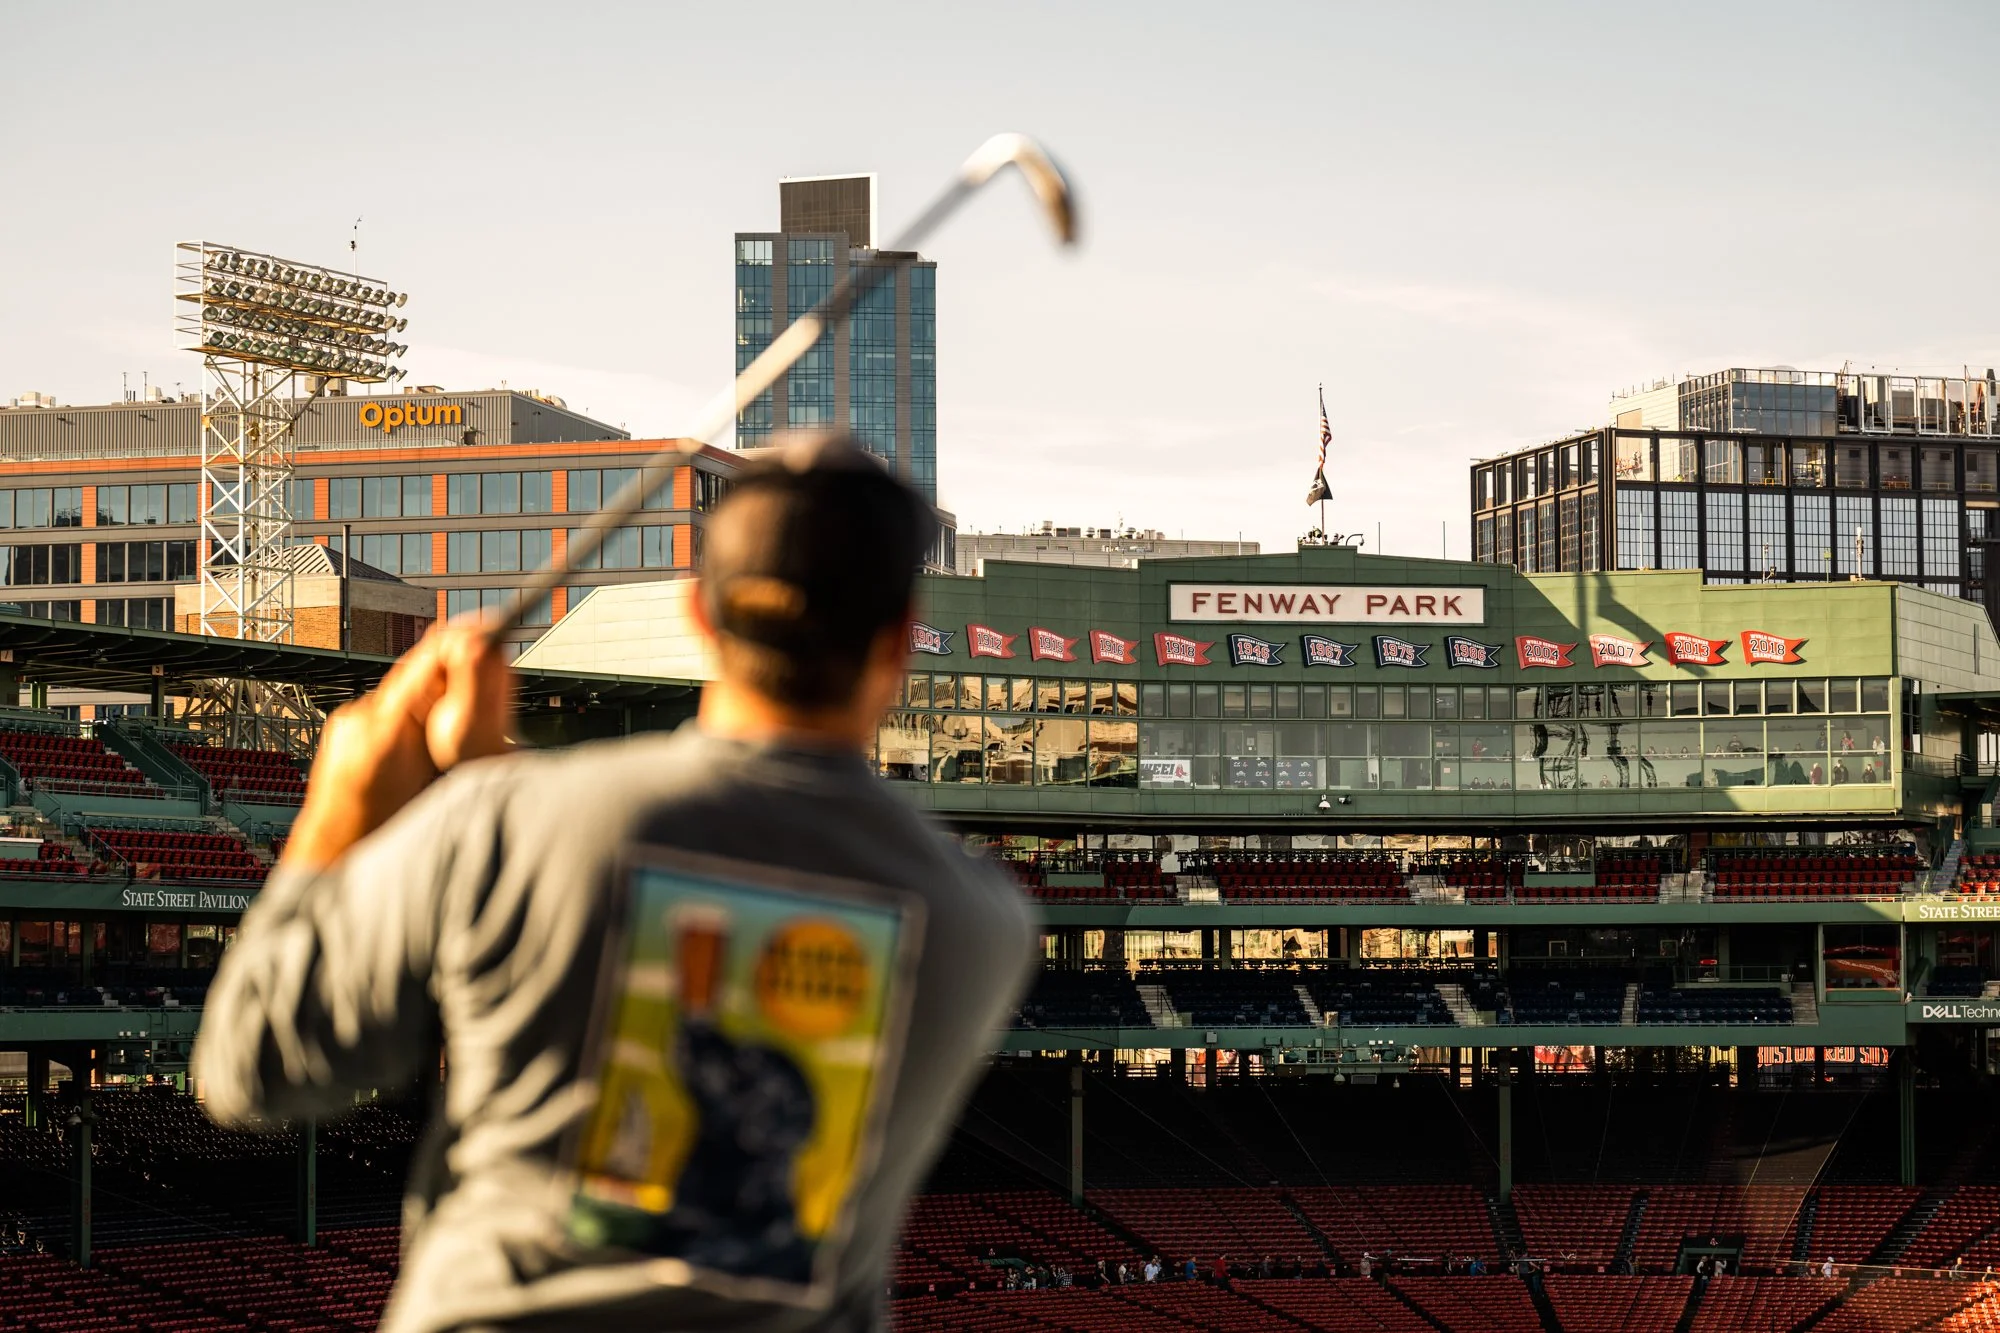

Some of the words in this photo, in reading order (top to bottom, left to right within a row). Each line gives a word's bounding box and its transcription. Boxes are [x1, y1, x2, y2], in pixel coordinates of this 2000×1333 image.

[360, 402, 462, 433] Optum
[1191, 593, 1342, 615] FENWAY
[1366, 594, 1463, 616] PARK
[912, 629, 941, 648] 1904
[977, 633, 1002, 650] 1912
[1039, 636, 1064, 653] 1915
[1749, 639, 1786, 655] 2018
[1100, 639, 1124, 656] 1916
[1166, 641, 1196, 657] 1918
[1237, 642, 1270, 659] 1946
[1310, 643, 1342, 660] 1967
[1382, 643, 1415, 661] 1975
[1454, 644, 1487, 662] 1986
[1524, 645, 1559, 660] 2004
[1598, 642, 1634, 658] 2007
[1674, 641, 1710, 657] 2013
[122, 889, 155, 906] STATE
[156, 890, 196, 908] STREET
[199, 891, 249, 909] PAVILION
[1919, 905, 1959, 919] STATE
[1922, 1005, 1961, 1019] DELL
[1960, 1005, 2000, 1019] Techn
